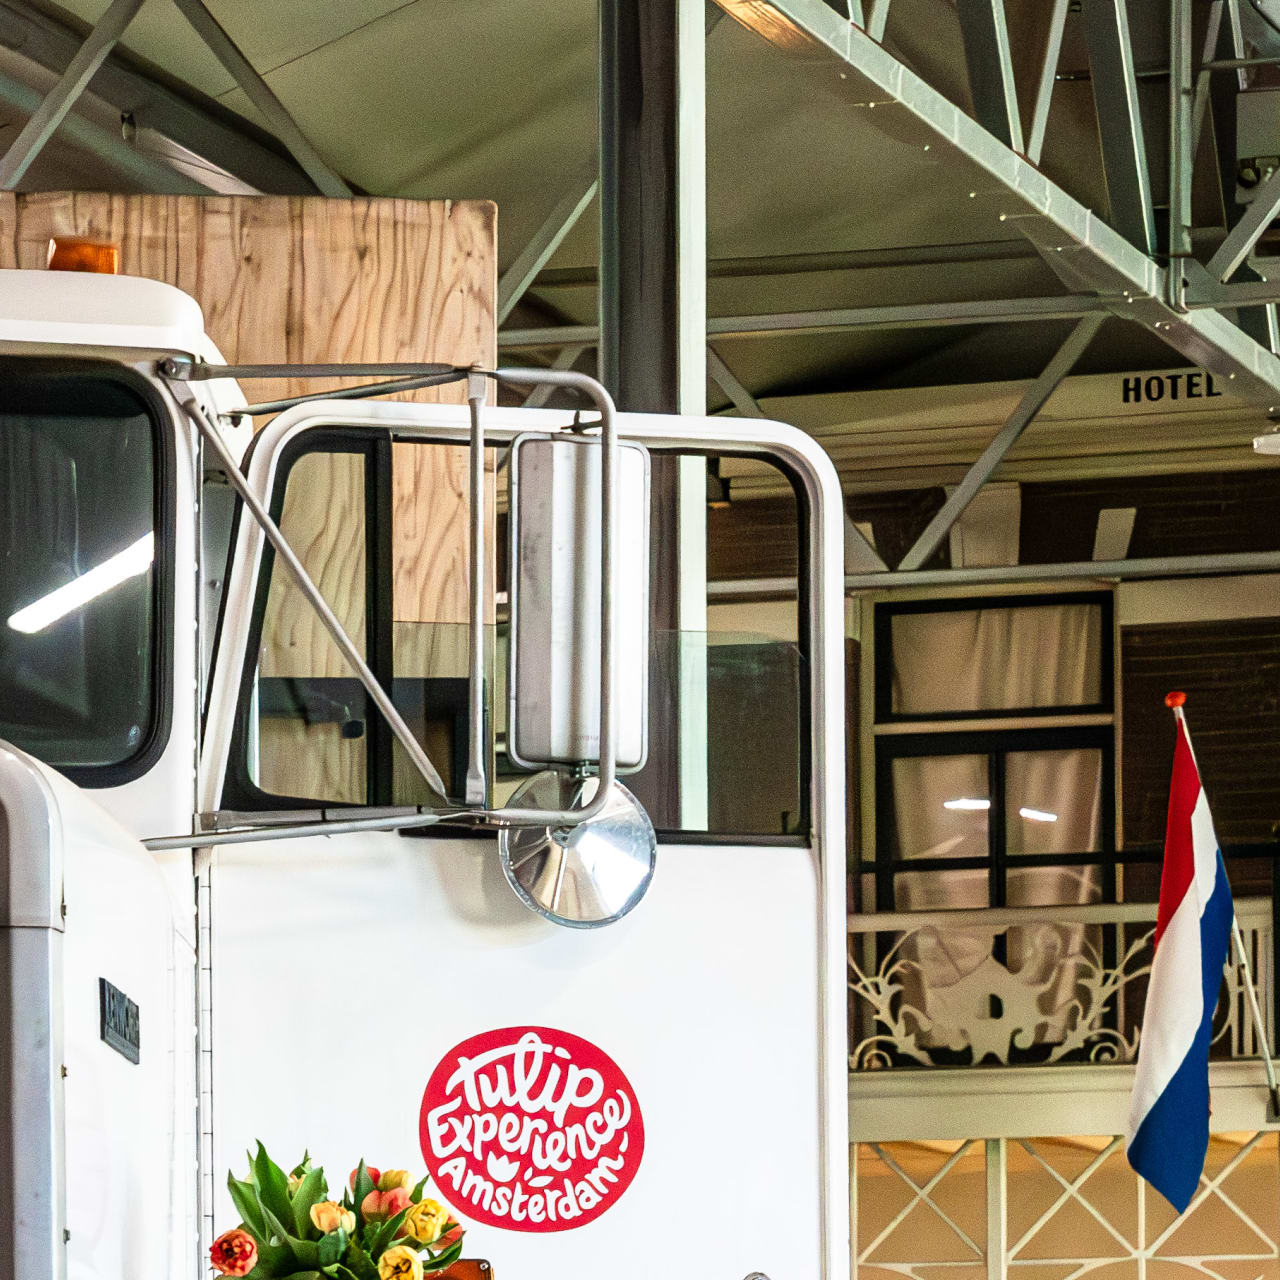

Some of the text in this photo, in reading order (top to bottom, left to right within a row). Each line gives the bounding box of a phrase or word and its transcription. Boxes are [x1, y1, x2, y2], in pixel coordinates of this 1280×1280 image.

[1122, 371, 1222, 403] HOTEL
[445, 1031, 605, 1128] Tulip
[426, 1089, 632, 1172] Experience
[437, 1154, 625, 1223] Amsterdam
